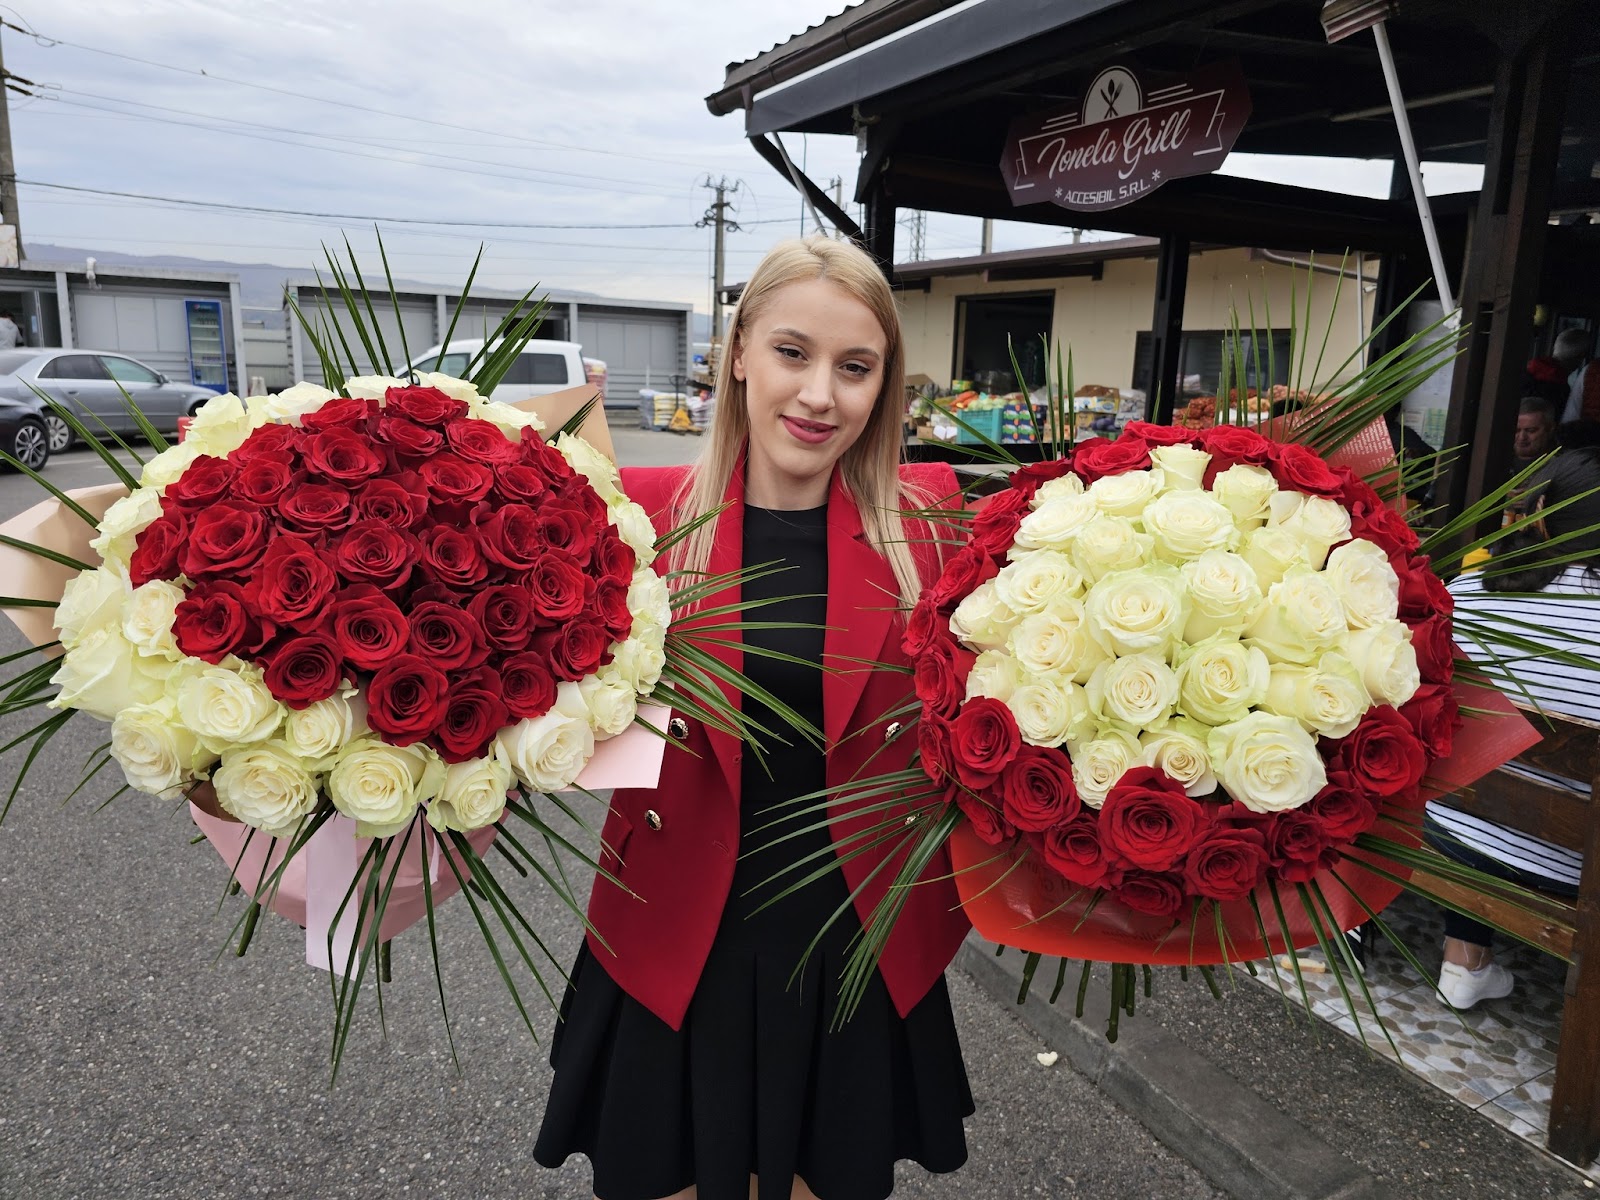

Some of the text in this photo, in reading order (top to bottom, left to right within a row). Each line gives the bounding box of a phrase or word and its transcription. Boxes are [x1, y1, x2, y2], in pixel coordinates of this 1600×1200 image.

[1119, 108, 1191, 180] Grill
[1064, 178, 1151, 204] ACCESIBIL S.R.L.
